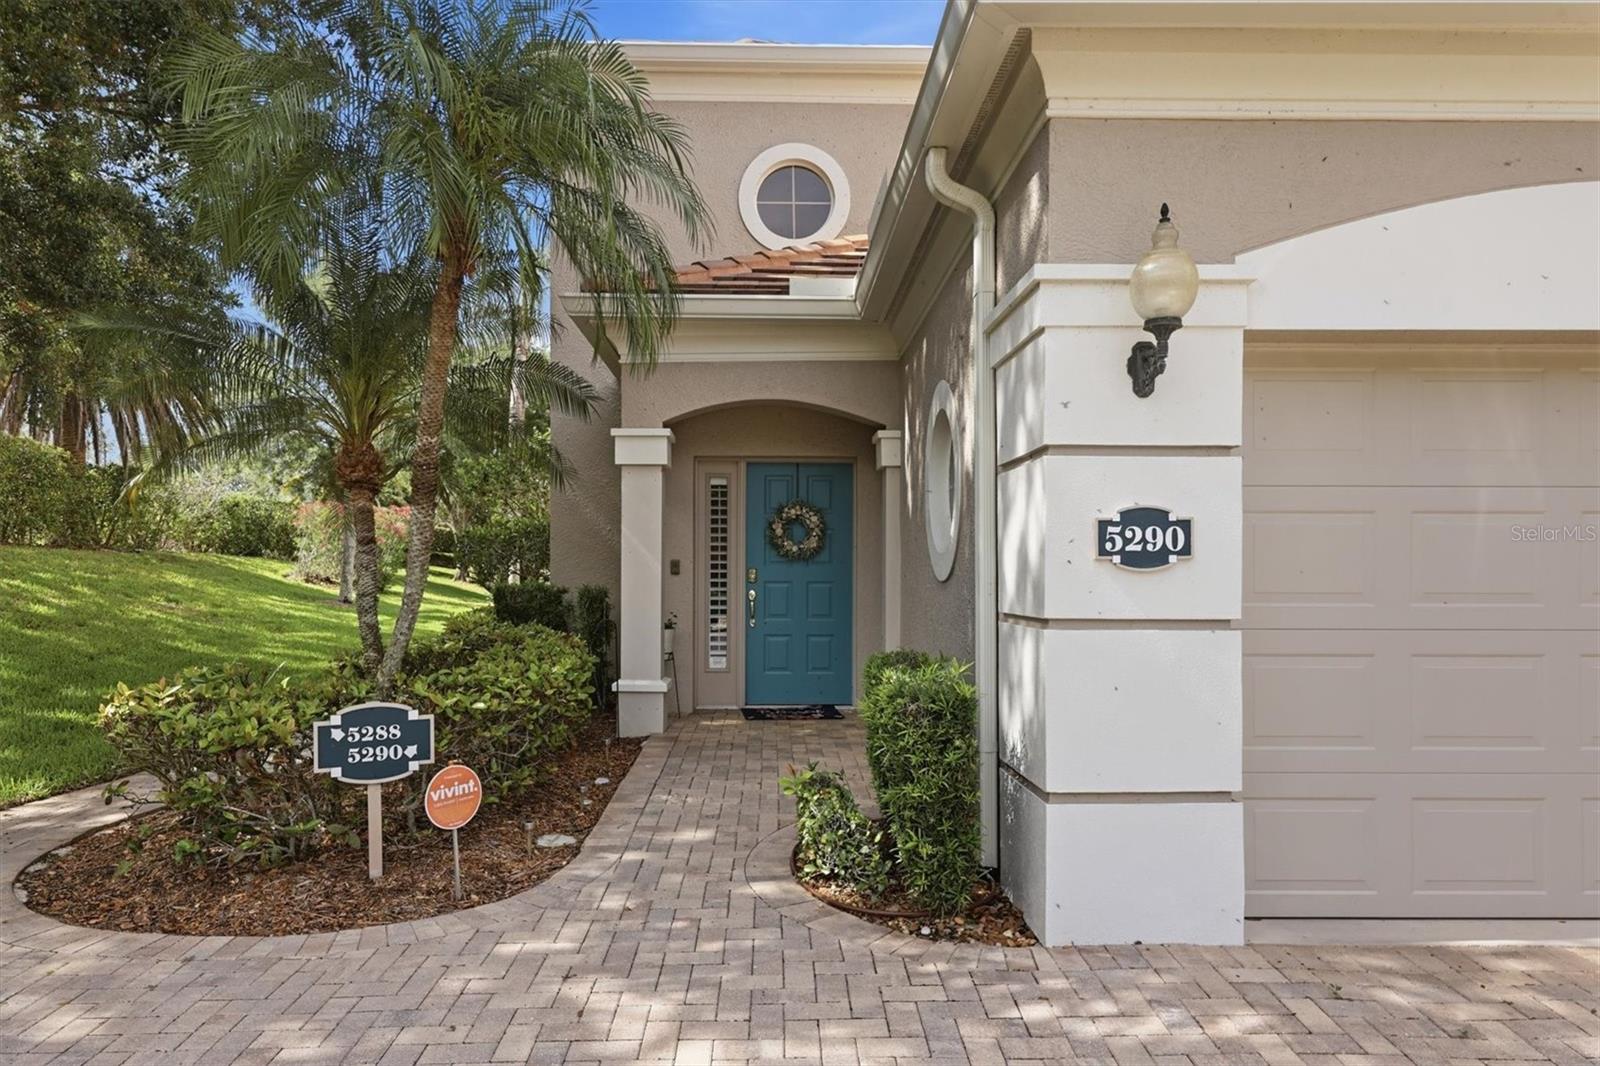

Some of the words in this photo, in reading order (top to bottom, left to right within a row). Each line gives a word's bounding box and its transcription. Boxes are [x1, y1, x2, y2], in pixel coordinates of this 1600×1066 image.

[1105, 525, 1185, 552] 5290
[347, 724, 401, 743] 5288
[347, 744, 403, 763] 5290
